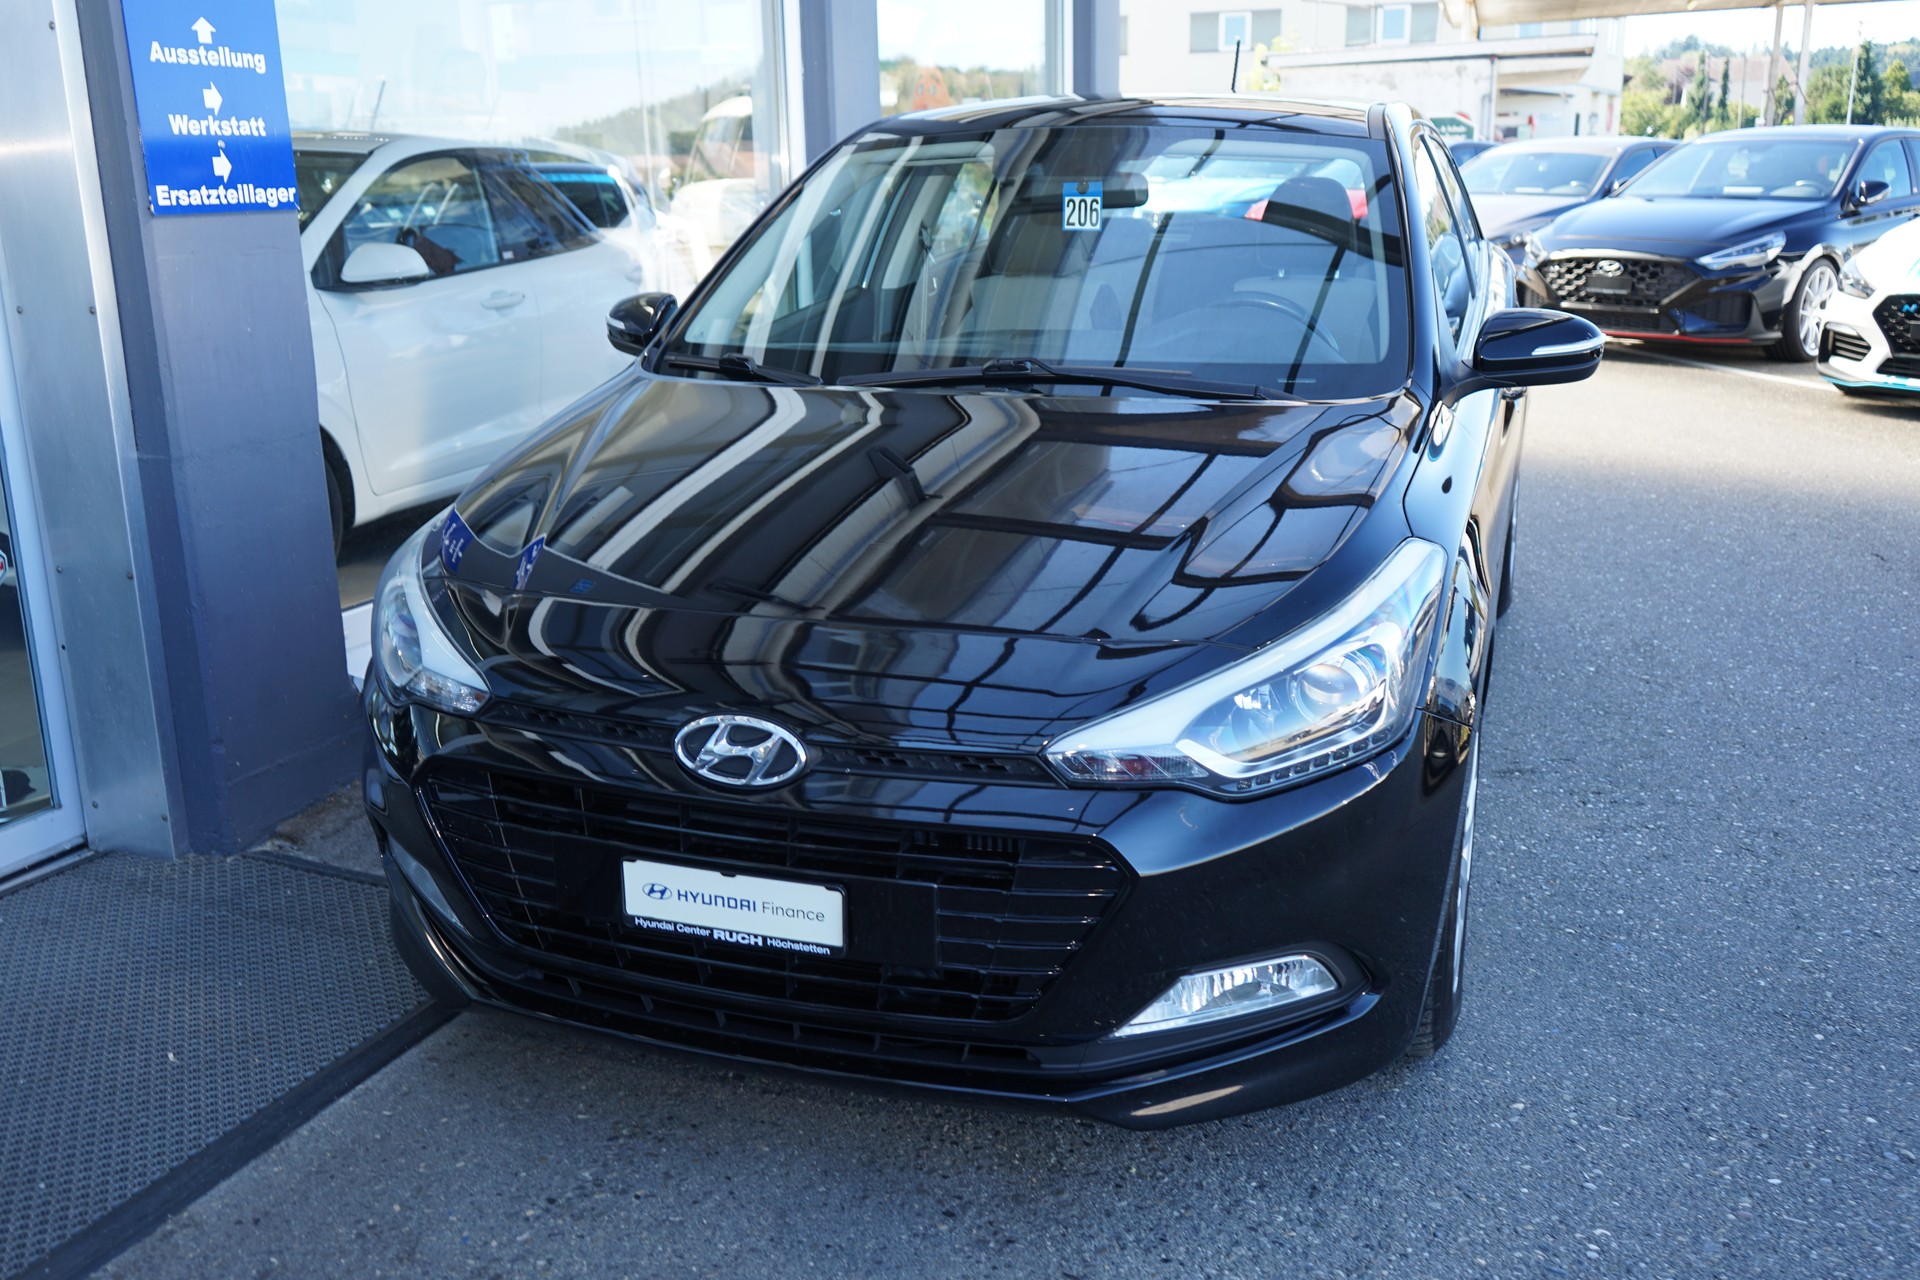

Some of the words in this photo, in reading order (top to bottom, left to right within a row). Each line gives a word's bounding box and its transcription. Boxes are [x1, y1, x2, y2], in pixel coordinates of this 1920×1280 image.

[150, 41, 266, 74] Ausstellung
[168, 114, 266, 136] Werkstatt
[156, 184, 296, 207] Ersatzteillager
[1066, 198, 1099, 227] 206
[677, 889, 757, 912] HYUNDAI
[762, 902, 825, 922] Finance
[634, 917, 674, 932] Hyundai
[676, 924, 711, 937] Center
[713, 929, 763, 946] RUCH
[767, 937, 831, 955] Höchstetten
